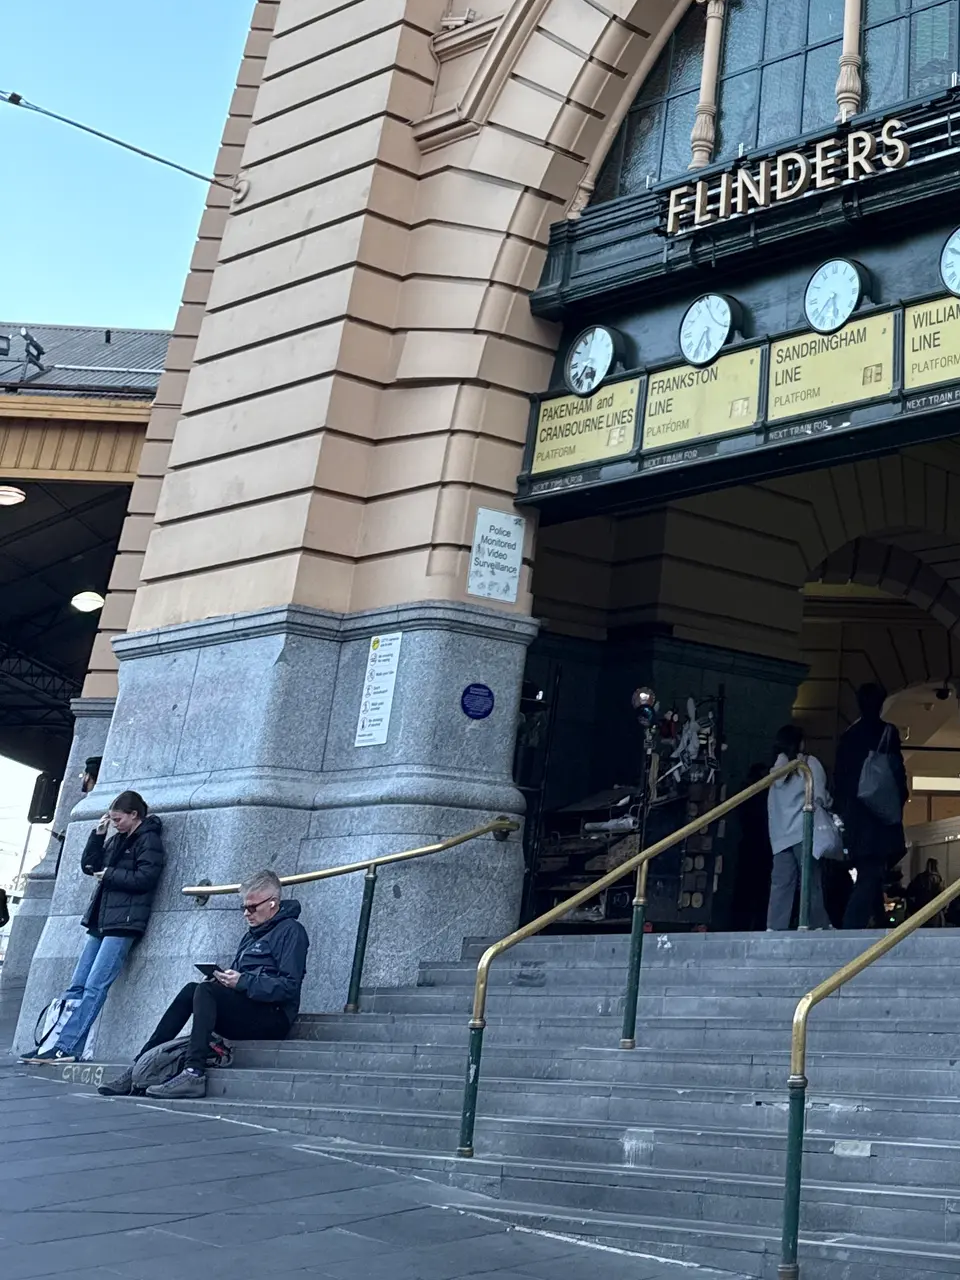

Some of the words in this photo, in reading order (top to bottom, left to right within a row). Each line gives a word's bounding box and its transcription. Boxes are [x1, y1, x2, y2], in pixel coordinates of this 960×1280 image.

[666, 119, 910, 234] FLINDERS
[776, 327, 867, 364] SANDRINGHAM
[911, 331, 941, 352] LINE
[650, 367, 718, 396] FRANKSTON
[775, 365, 801, 386] LINE
[774, 387, 821, 407] PLATFORM
[906, 398, 927, 409] NEXT
[929, 392, 953, 405] TRAIN
[541, 398, 593, 422] PAKENHAM
[596, 393, 614, 410] and
[649, 398, 673, 418] LINE
[539, 419, 604, 443] CRANBOURNE
[606, 409, 634, 428] LINES
[646, 419, 690, 438] PLATFORM
[769, 429, 787, 440] NEXT
[790, 424, 811, 436] TRAIN
[536, 445, 576, 463] PLATFORM
[489, 525, 511, 538] Police
[481, 535, 517, 551] Monitored
[487, 548, 508, 560] Video
[474, 557, 517, 574] Surveillance
